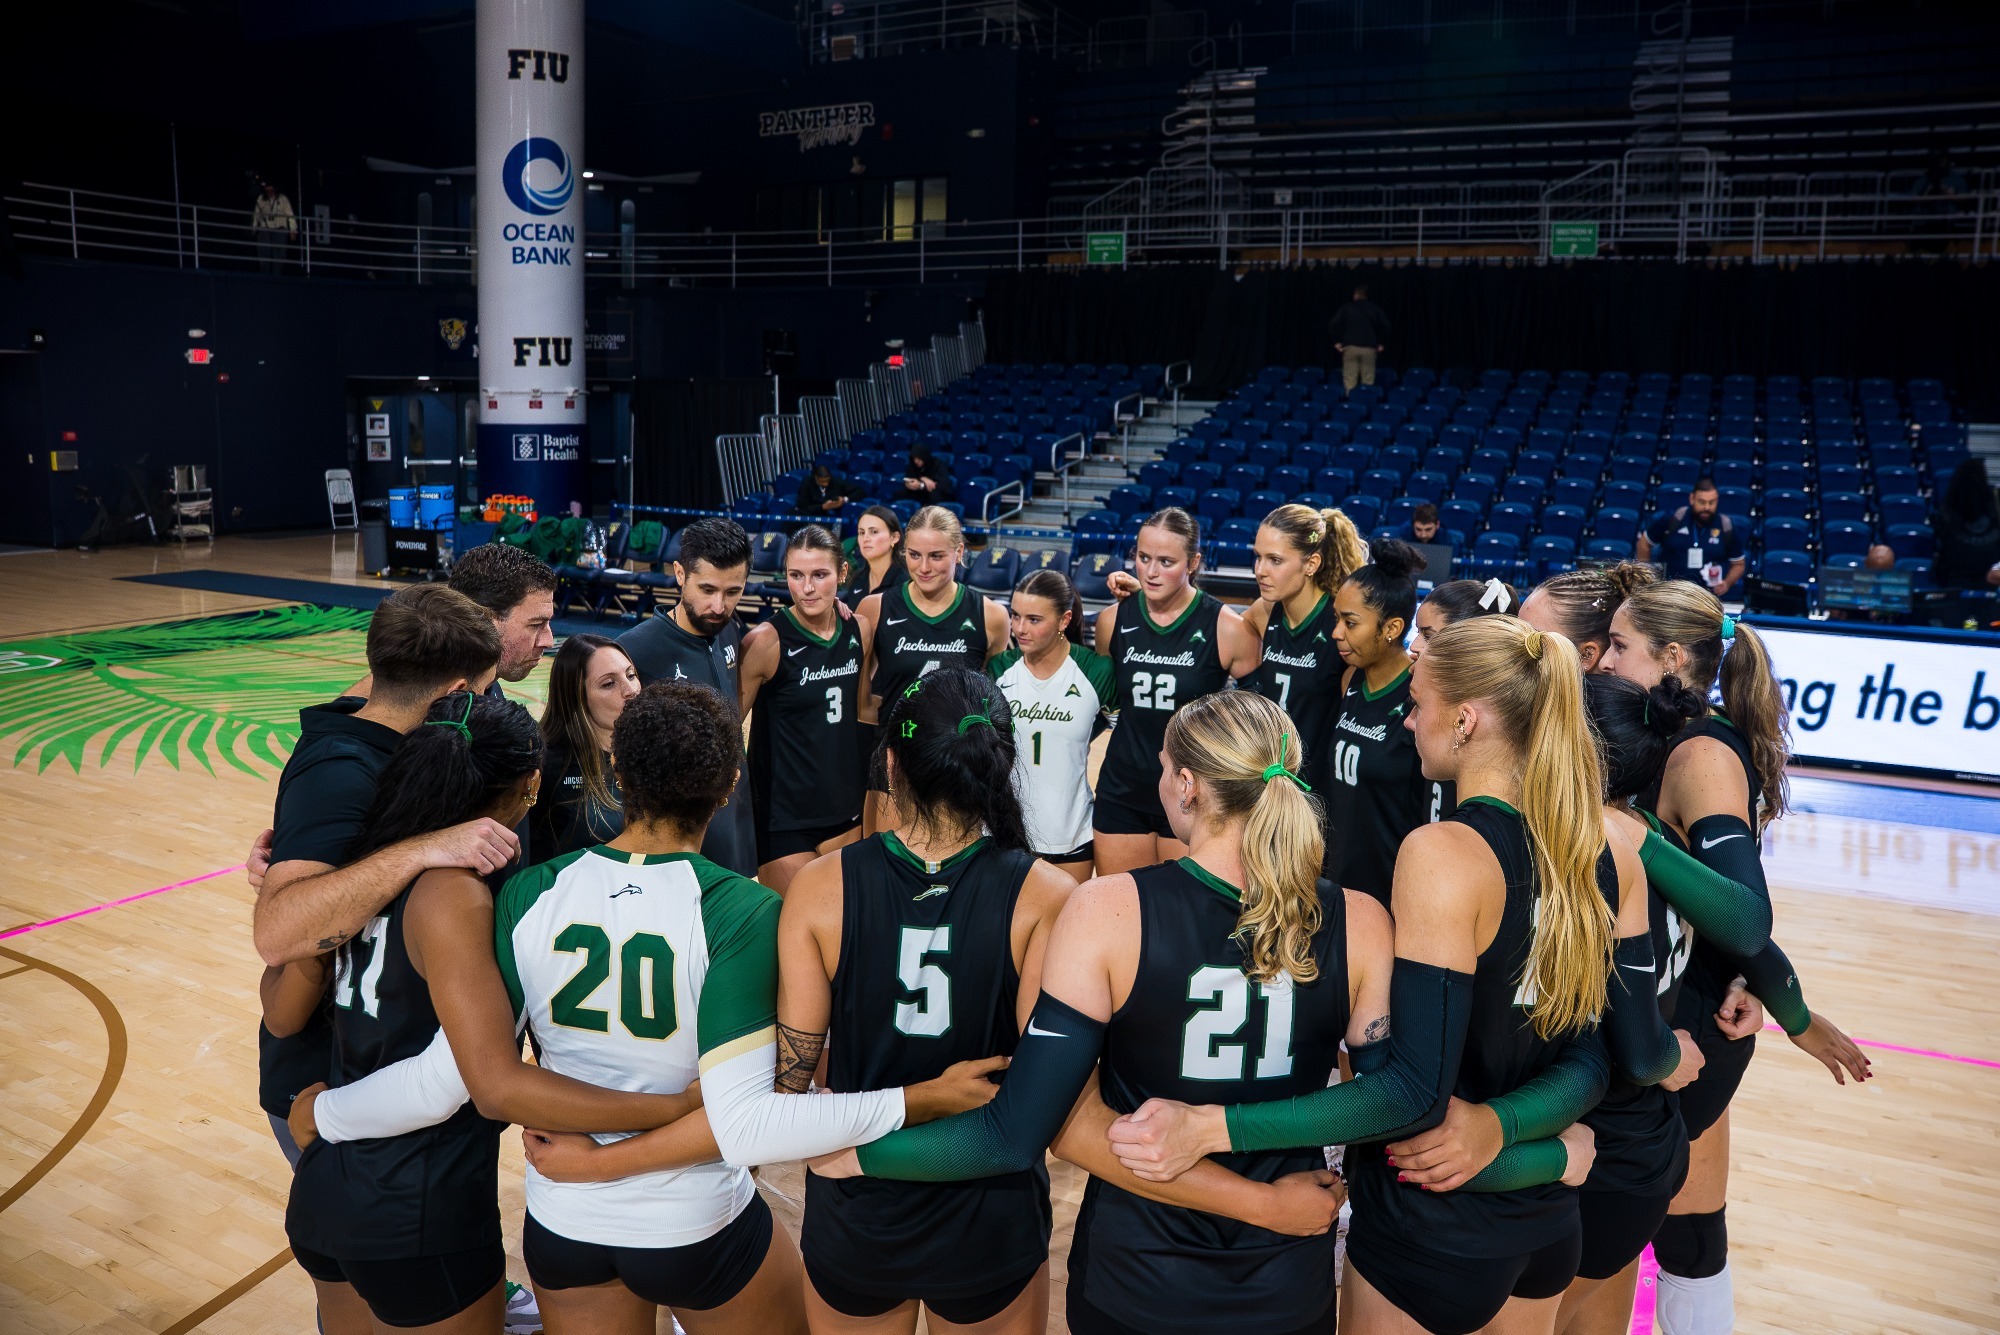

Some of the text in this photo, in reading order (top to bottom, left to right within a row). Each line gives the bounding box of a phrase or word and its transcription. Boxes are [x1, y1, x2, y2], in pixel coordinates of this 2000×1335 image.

[508, 49, 570, 83] FIU
[759, 101, 876, 137] PANTHER
[503, 223, 575, 243] OCEAN
[512, 246, 571, 266] BANK
[513, 337, 572, 367] FIU
[543, 434, 580, 447] Baptist
[543, 448, 579, 461] Health
[894, 636, 968, 654] Jacksonville
[1123, 646, 1195, 667] Jacksonville
[1263, 645, 1316, 668] Jacksonville
[800, 658, 859, 686] Jacksonville
[825, 686, 843, 724] 3
[1132, 671, 1176, 711] 22
[1275, 672, 1291, 711] 7
[1781, 663, 2000, 732] ng the b
[1009, 700, 1074, 724] Dolphins
[1335, 712, 1387, 742] Jacksonville
[1031, 731, 1042, 766] 1
[1335, 740, 1361, 787] 10
[335, 914, 391, 1020] 17
[548, 920, 681, 1043] 20
[893, 924, 953, 1039] 5
[1179, 963, 1296, 1082] 21
